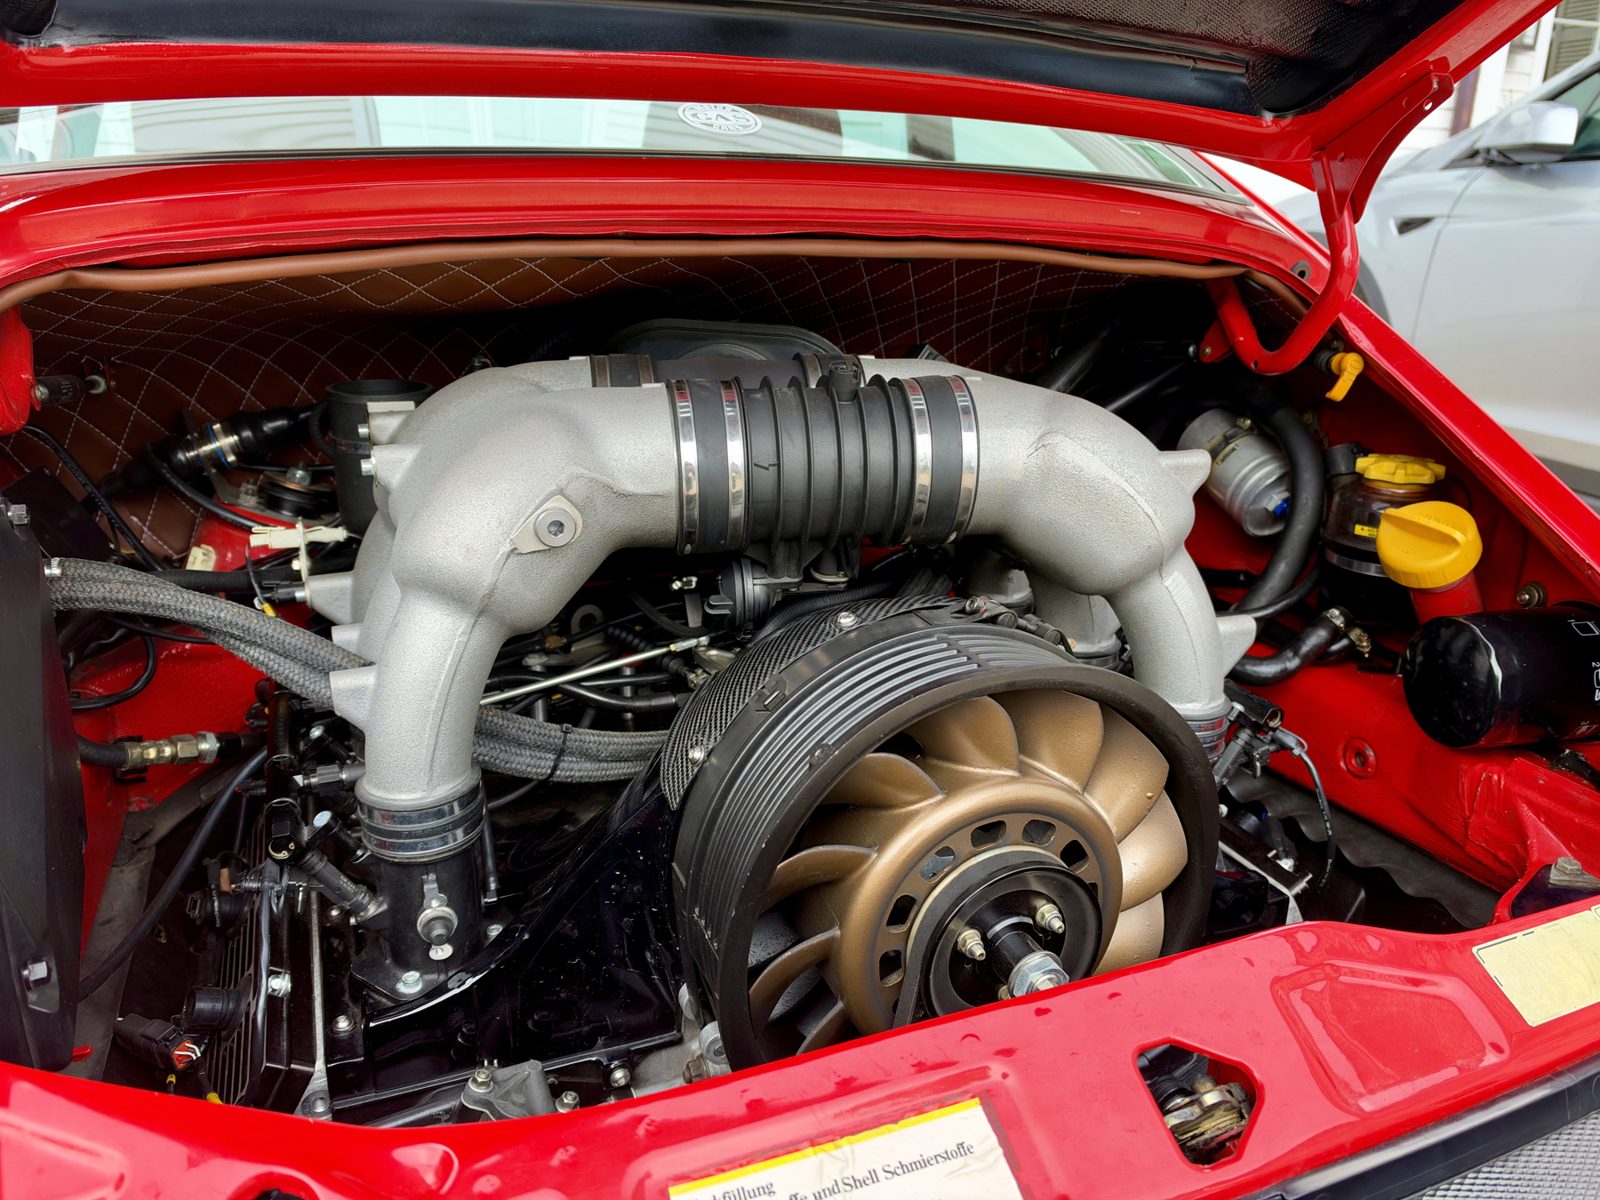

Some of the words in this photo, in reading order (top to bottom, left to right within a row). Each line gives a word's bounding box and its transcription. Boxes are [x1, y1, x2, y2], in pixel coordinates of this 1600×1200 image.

[812, 1179, 840, 1200] und
[841, 1168, 880, 1193] Shell
[881, 1141, 975, 1180] Schmierstoffe
